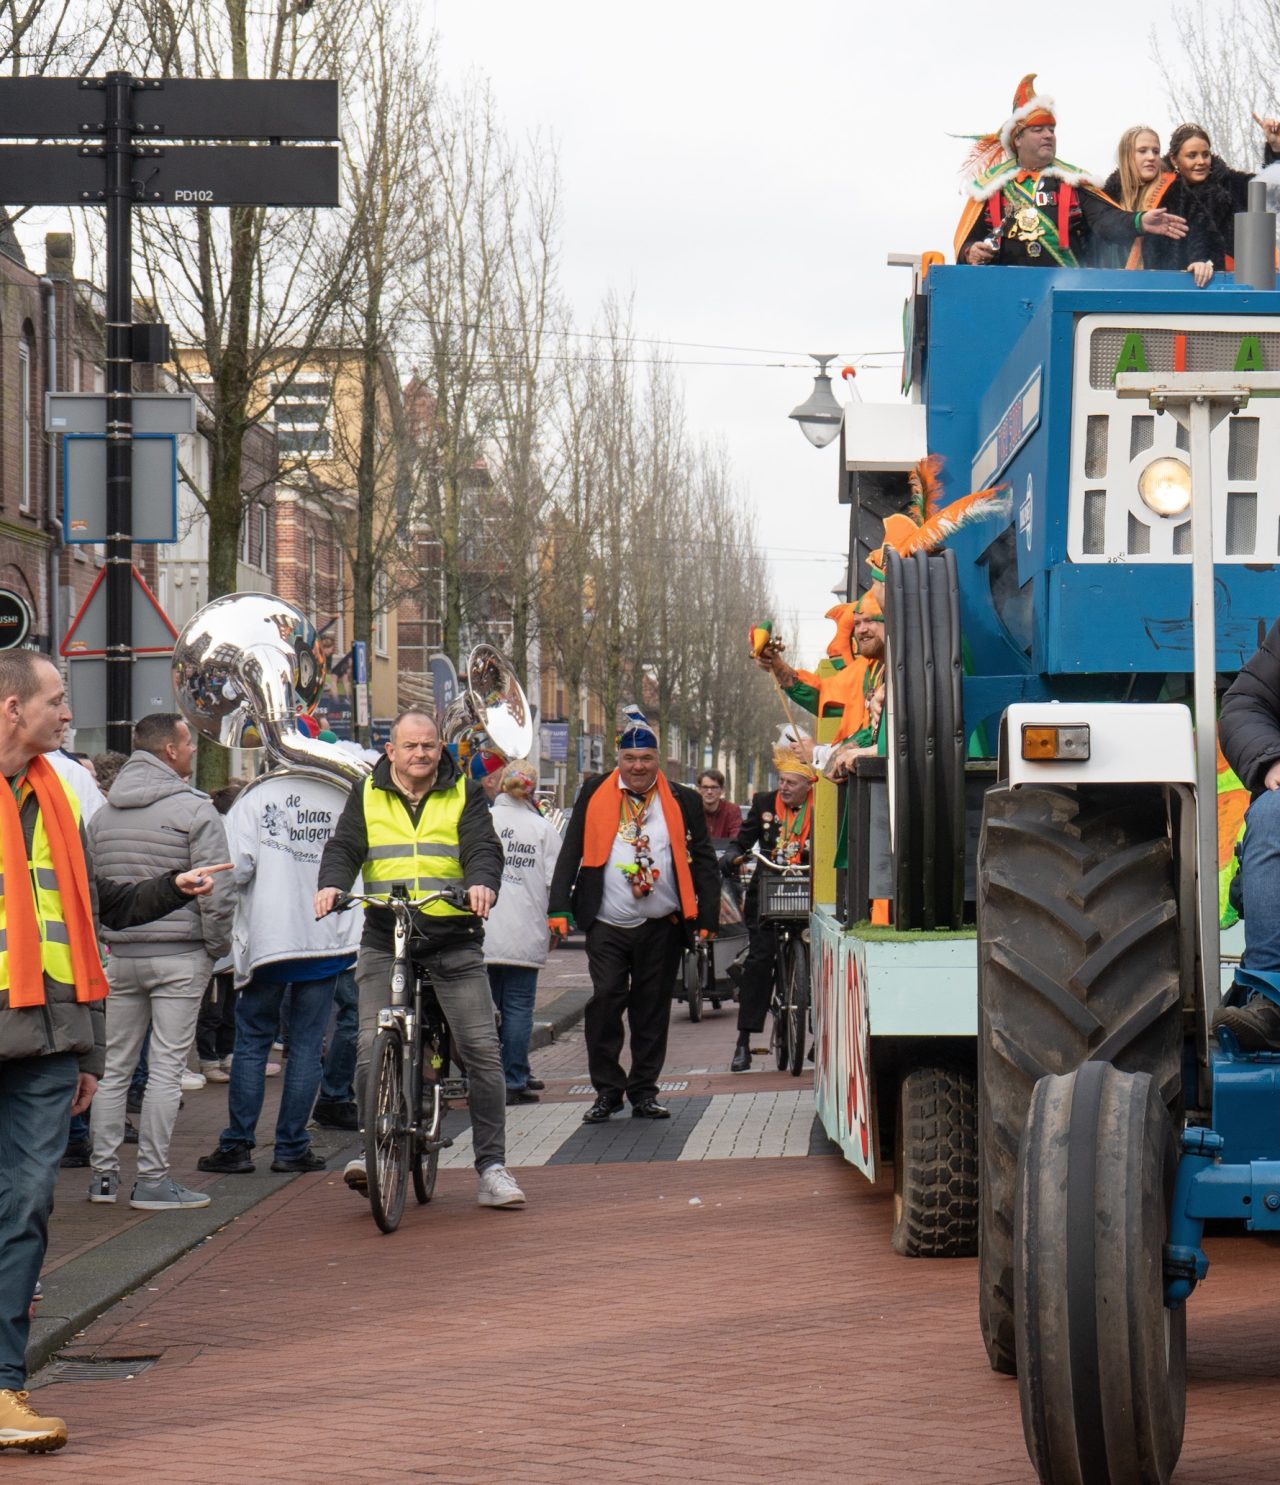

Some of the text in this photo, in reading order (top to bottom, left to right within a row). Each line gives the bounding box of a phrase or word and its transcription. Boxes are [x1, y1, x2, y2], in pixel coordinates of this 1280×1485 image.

[174, 190, 214, 201] PD102
[285, 794, 301, 808] de
[297, 809, 332, 824] blaas
[290, 826, 331, 843] balgen
[501, 827, 514, 839] de
[507, 841, 537, 854] blaas
[504, 855, 536, 869] algen
